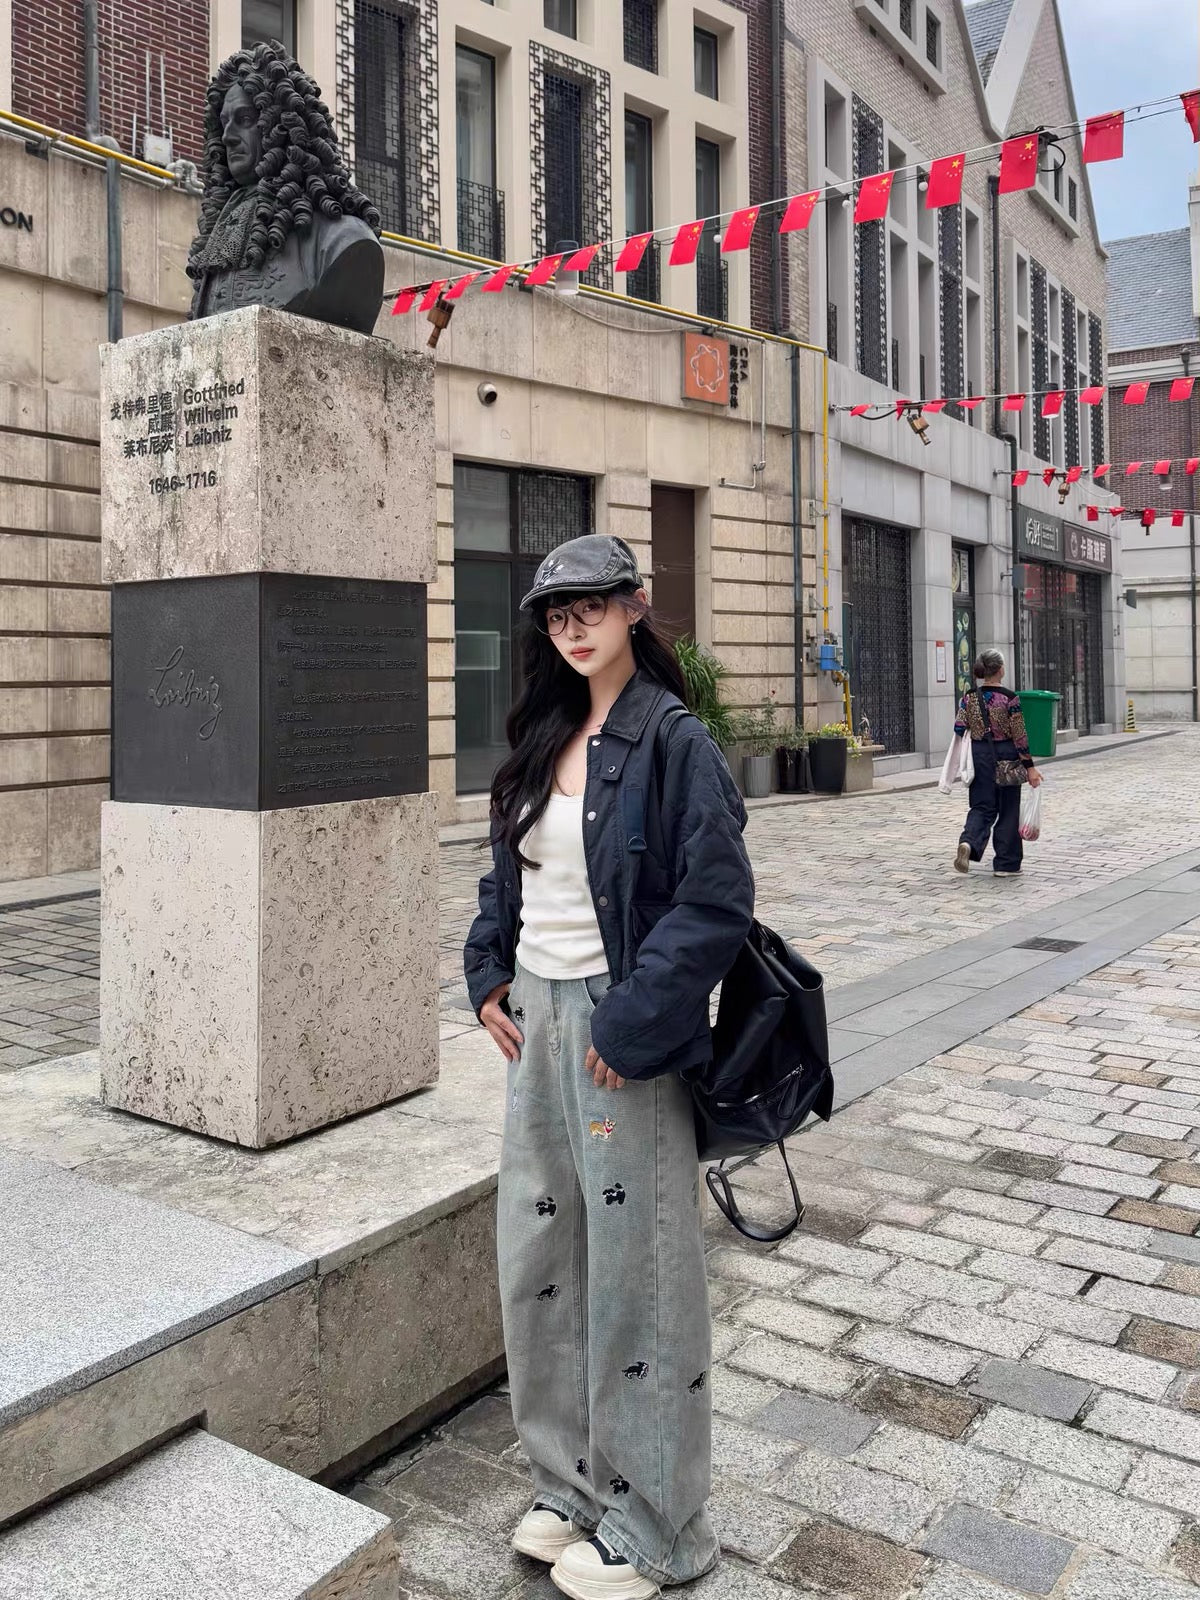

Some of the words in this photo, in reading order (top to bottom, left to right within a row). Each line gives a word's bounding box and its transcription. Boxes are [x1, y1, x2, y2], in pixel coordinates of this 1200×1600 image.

[740, 347, 749, 380] CRA
[183, 378, 245, 405] Gottfried
[110, 391, 173, 421] 戈特弗里德
[184, 404, 238, 426] Wilhelm
[147, 412, 175, 435] 威廉
[123, 433, 175, 459] 莱布尼茨
[185, 426, 232, 448] Leibniz
